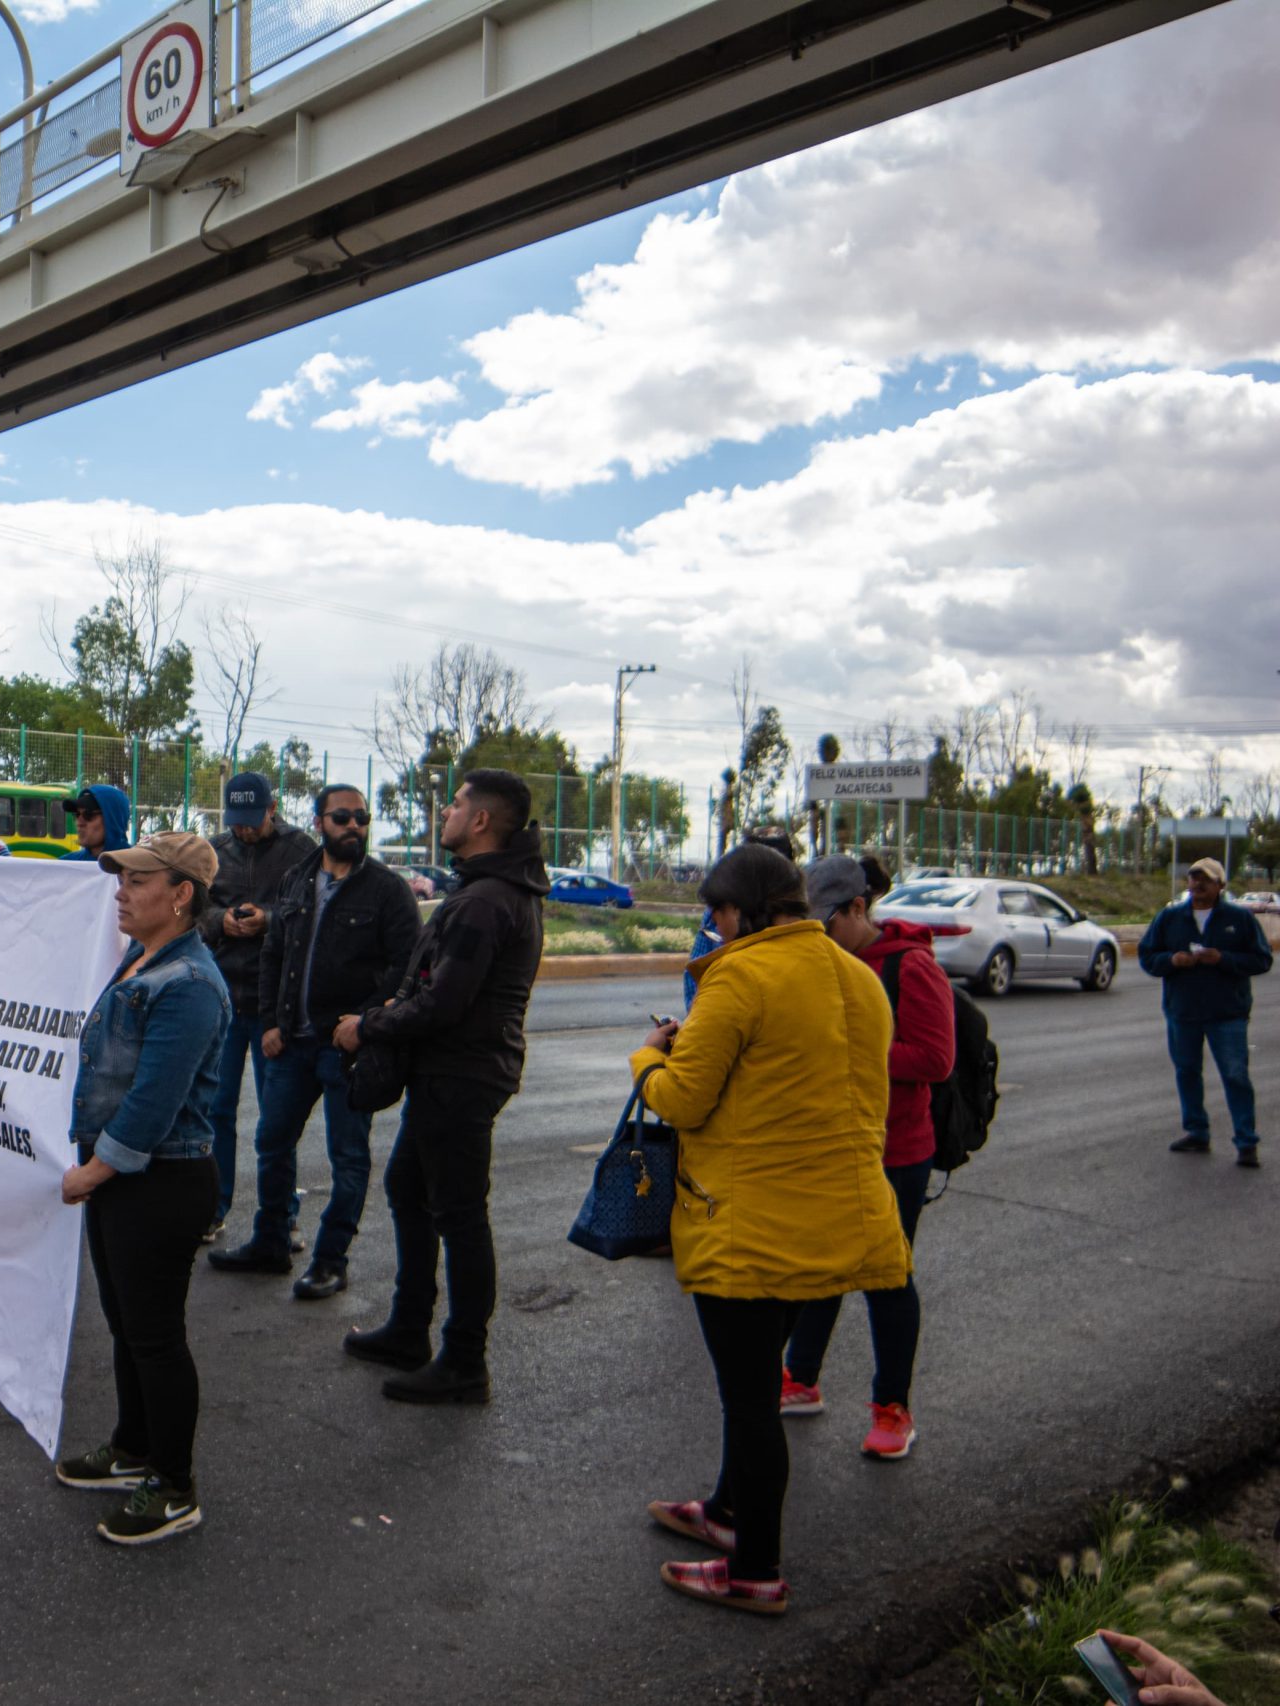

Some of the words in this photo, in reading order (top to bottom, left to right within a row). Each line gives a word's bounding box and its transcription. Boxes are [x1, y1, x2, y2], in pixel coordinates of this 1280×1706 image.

[145, 48, 181, 100] 60
[811, 768, 835, 779] FELIZ
[886, 765, 921, 777] DESEA
[835, 783, 893, 795] ZACATECAS
[230, 791, 255, 803] PERITO
[37, 1050, 64, 1080] AL
